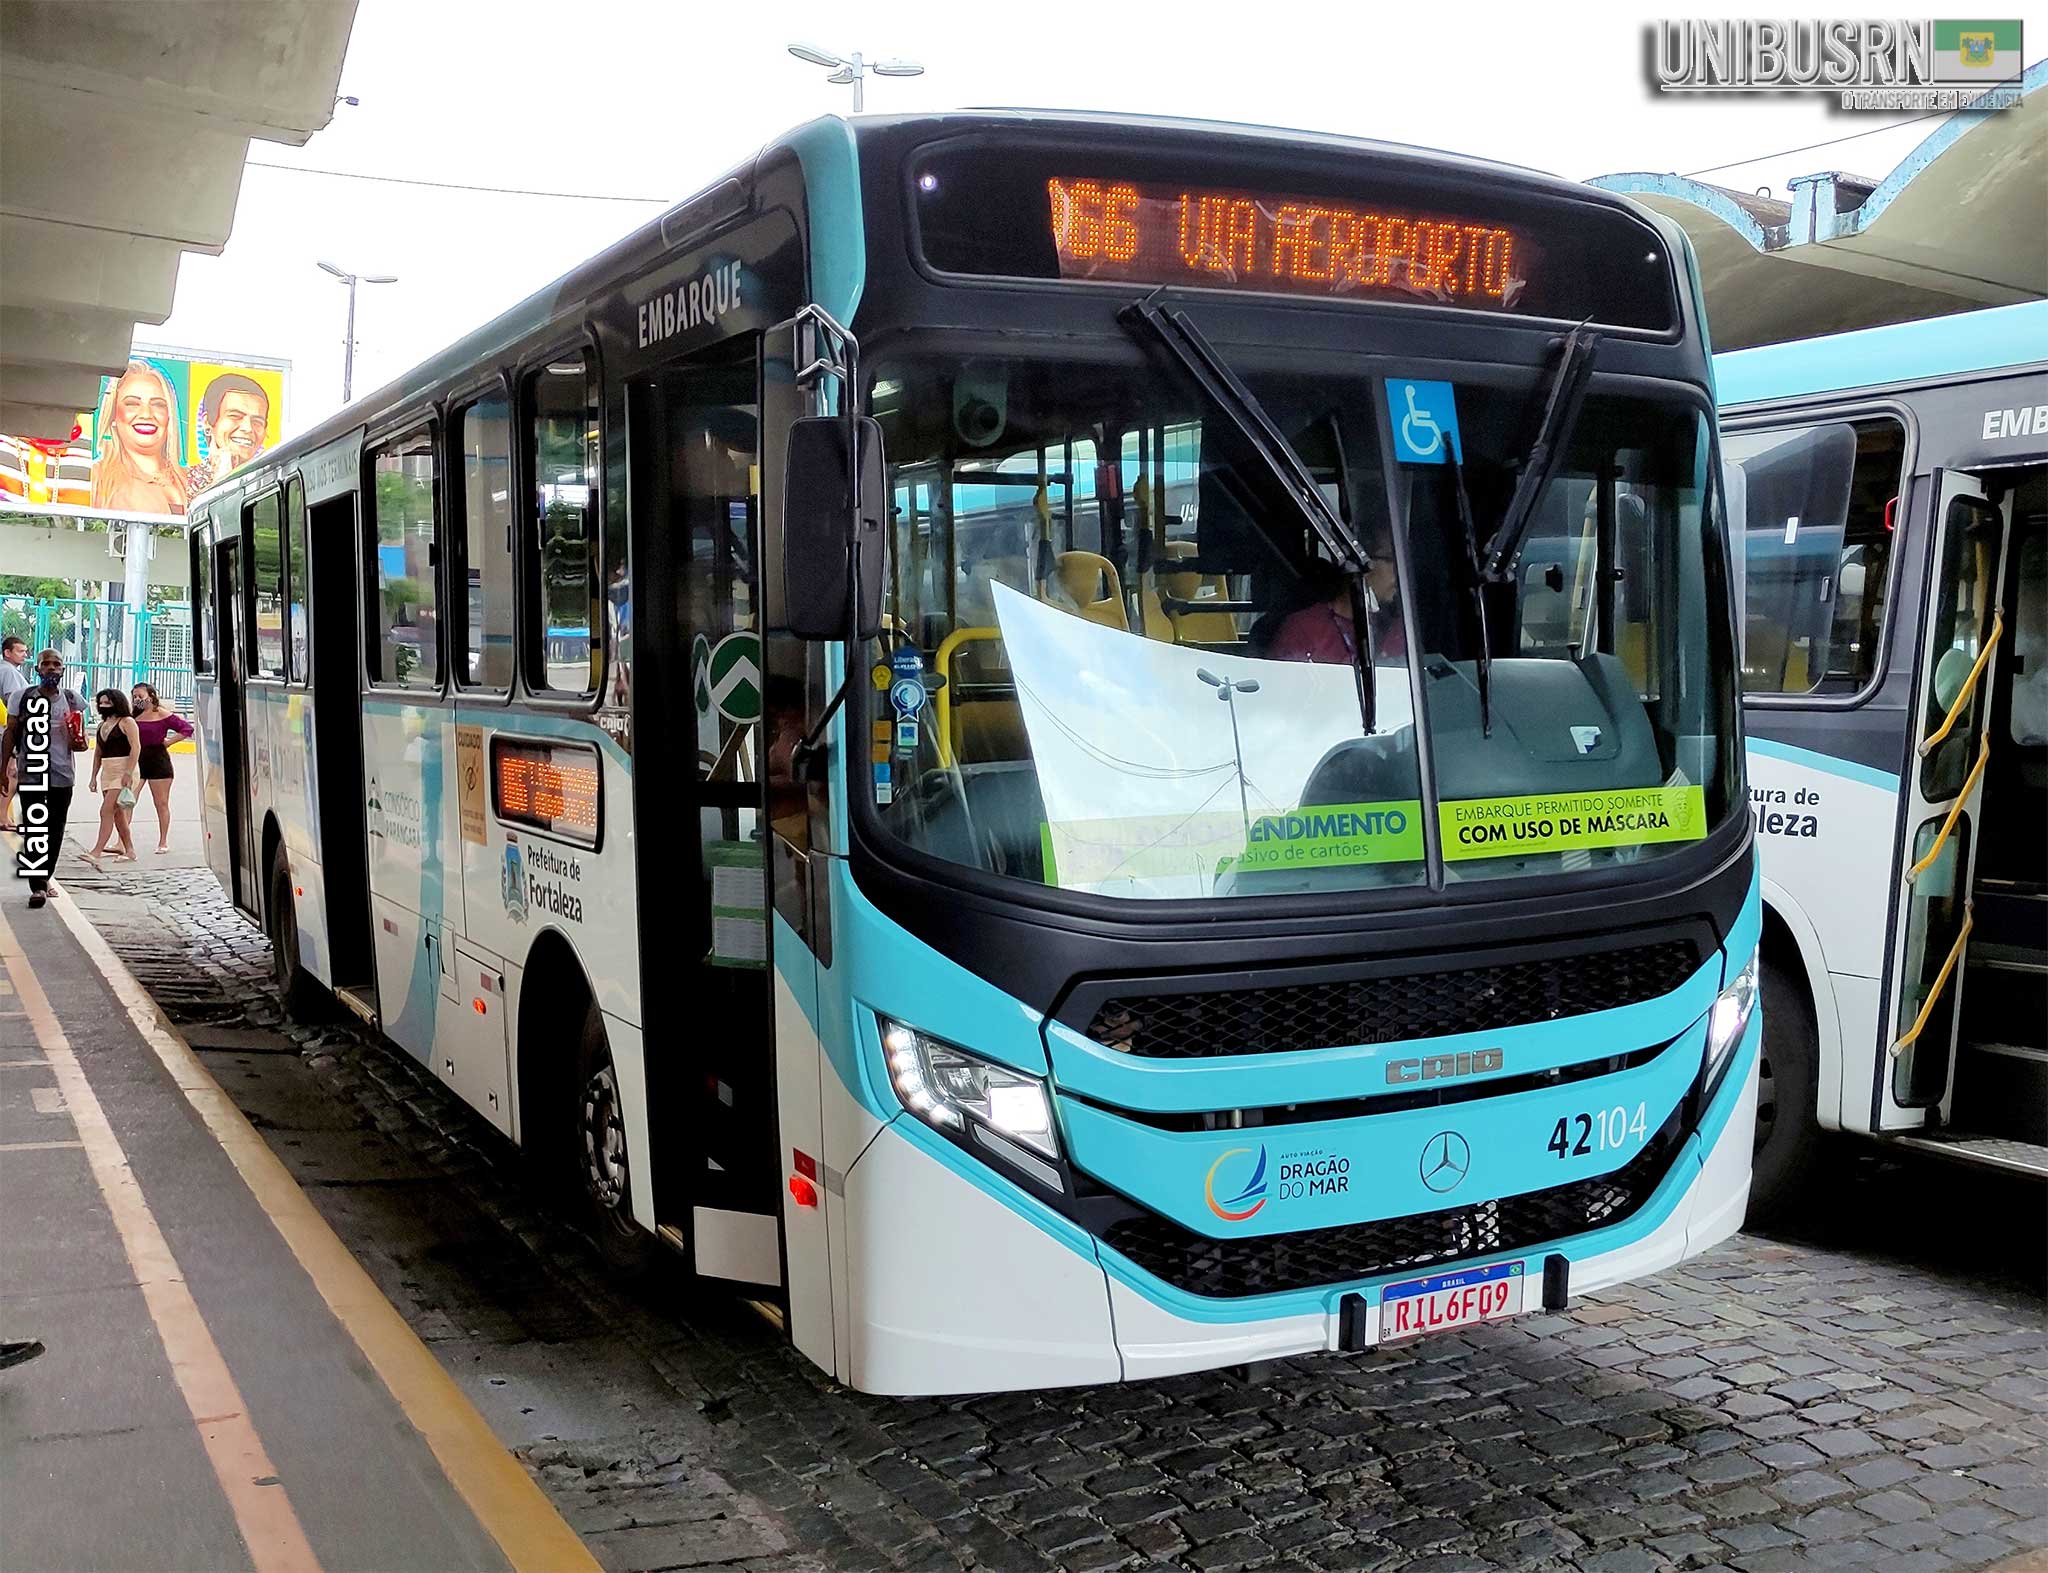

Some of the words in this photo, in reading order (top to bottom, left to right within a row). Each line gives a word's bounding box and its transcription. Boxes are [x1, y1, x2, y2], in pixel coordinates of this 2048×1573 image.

[1181, 194, 1255, 272] VIA
[1272, 205, 1513, 296] AEROPORTO
[638, 259, 742, 349] EMBARQUE
[1982, 405, 2048, 440] EMB
[1456, 803, 1532, 821] EMBARQUE
[1537, 797, 1604, 815] PERMITIDO
[1609, 793, 1663, 810] SOMENTE
[1794, 787, 1820, 806] de
[1459, 823, 1507, 844] COM
[1513, 818, 1554, 840] USO
[1560, 817, 1582, 836] DE
[1587, 810, 1670, 833] MÁSCARA
[527, 844, 568, 878] Prefeitura
[569, 856, 581, 882] de
[1285, 844, 1306, 861] de
[1310, 841, 1370, 858] cartões
[529, 873, 583, 924] Fortaleza
[1547, 1101, 1648, 1160] 42104
[1280, 1154, 1350, 1181] DRAGÃO
[1279, 1181, 1305, 1200] DO
[1309, 1176, 1349, 1197] MAR
[1442, 1278, 1466, 1289] BRASIL
